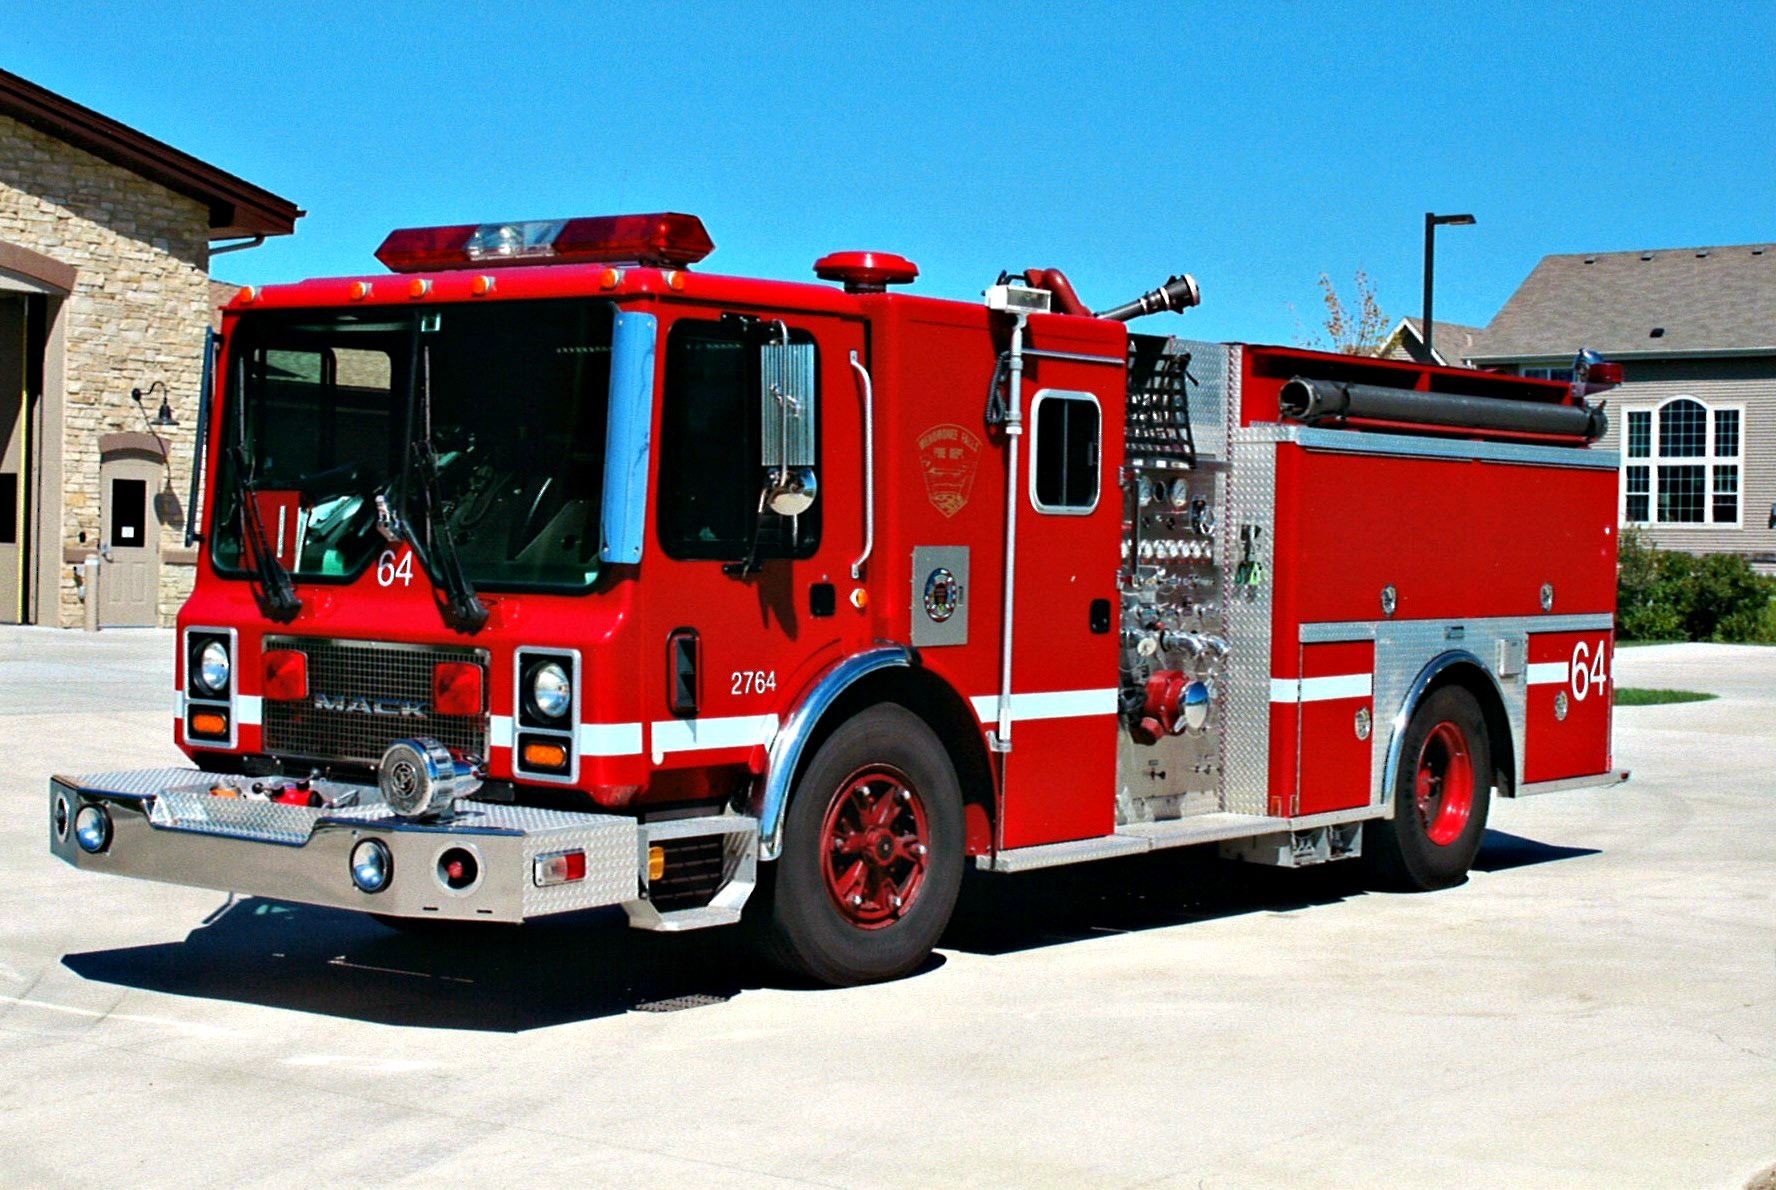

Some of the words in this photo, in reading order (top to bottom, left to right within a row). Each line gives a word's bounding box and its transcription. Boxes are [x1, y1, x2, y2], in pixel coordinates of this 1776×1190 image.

[377, 549, 413, 587] 64
[731, 670, 776, 695] 2764
[1571, 639, 1607, 701] 64
[314, 693, 428, 719] MACK
